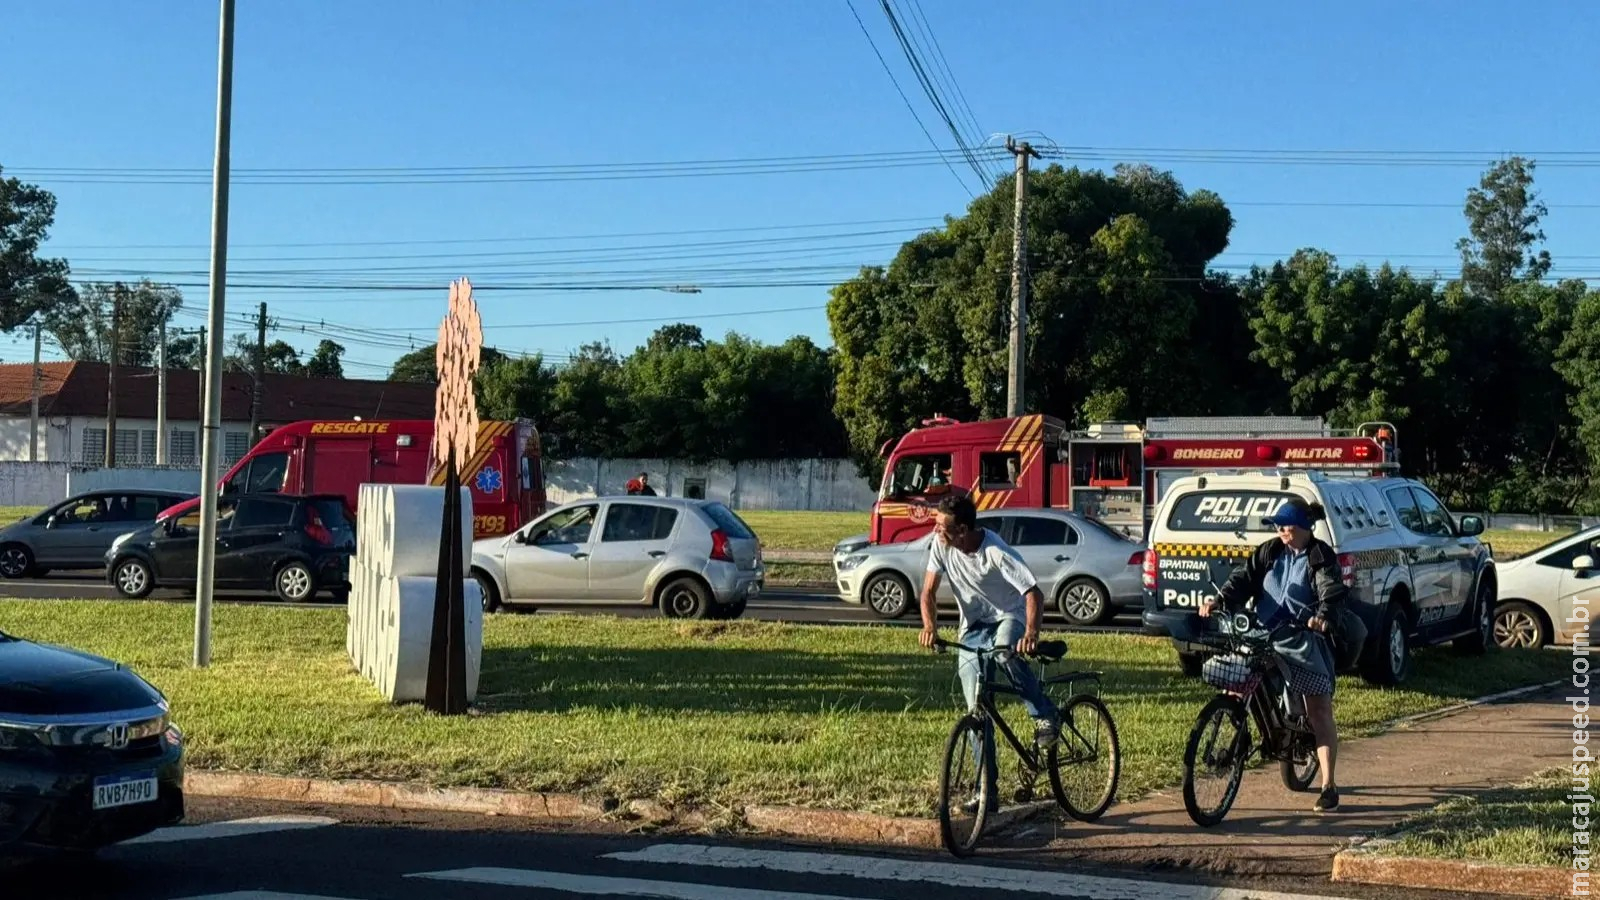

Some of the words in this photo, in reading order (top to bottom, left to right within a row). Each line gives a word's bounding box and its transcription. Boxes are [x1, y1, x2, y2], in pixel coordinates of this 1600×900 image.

[311, 422, 390, 434] RESGATE
[1173, 448, 1245, 460] BOMBEIRO
[1284, 447, 1343, 459] MILITAR
[480, 515, 506, 533] 193
[1201, 515, 1240, 524] MILITAR
[1159, 559, 1207, 570] BPMTRAN
[1162, 571, 1201, 582] 10.3045
[1163, 588, 1216, 607] Políc
[98, 780, 152, 806] RWB7H90
